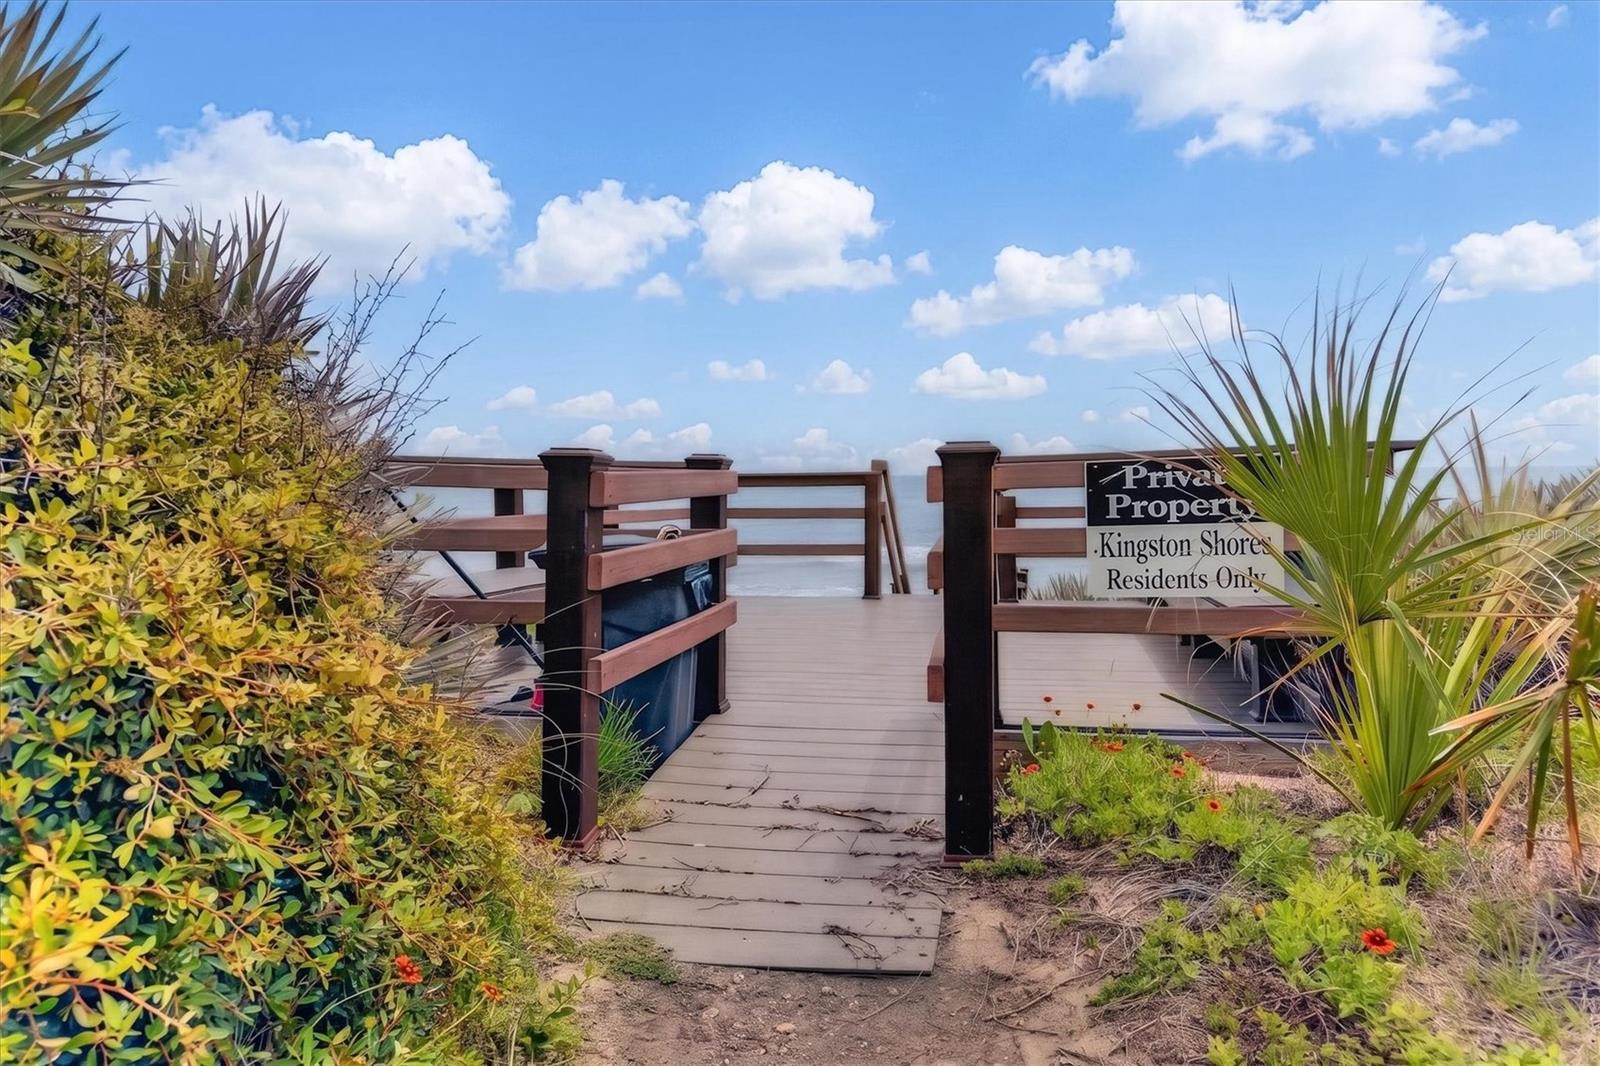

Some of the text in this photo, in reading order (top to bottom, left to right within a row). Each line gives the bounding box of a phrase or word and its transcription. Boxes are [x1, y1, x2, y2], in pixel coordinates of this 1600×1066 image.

[1122, 464, 1229, 489] Privat
[1098, 531, 1192, 564] Kingston
[1107, 565, 1266, 593] Residents Only
